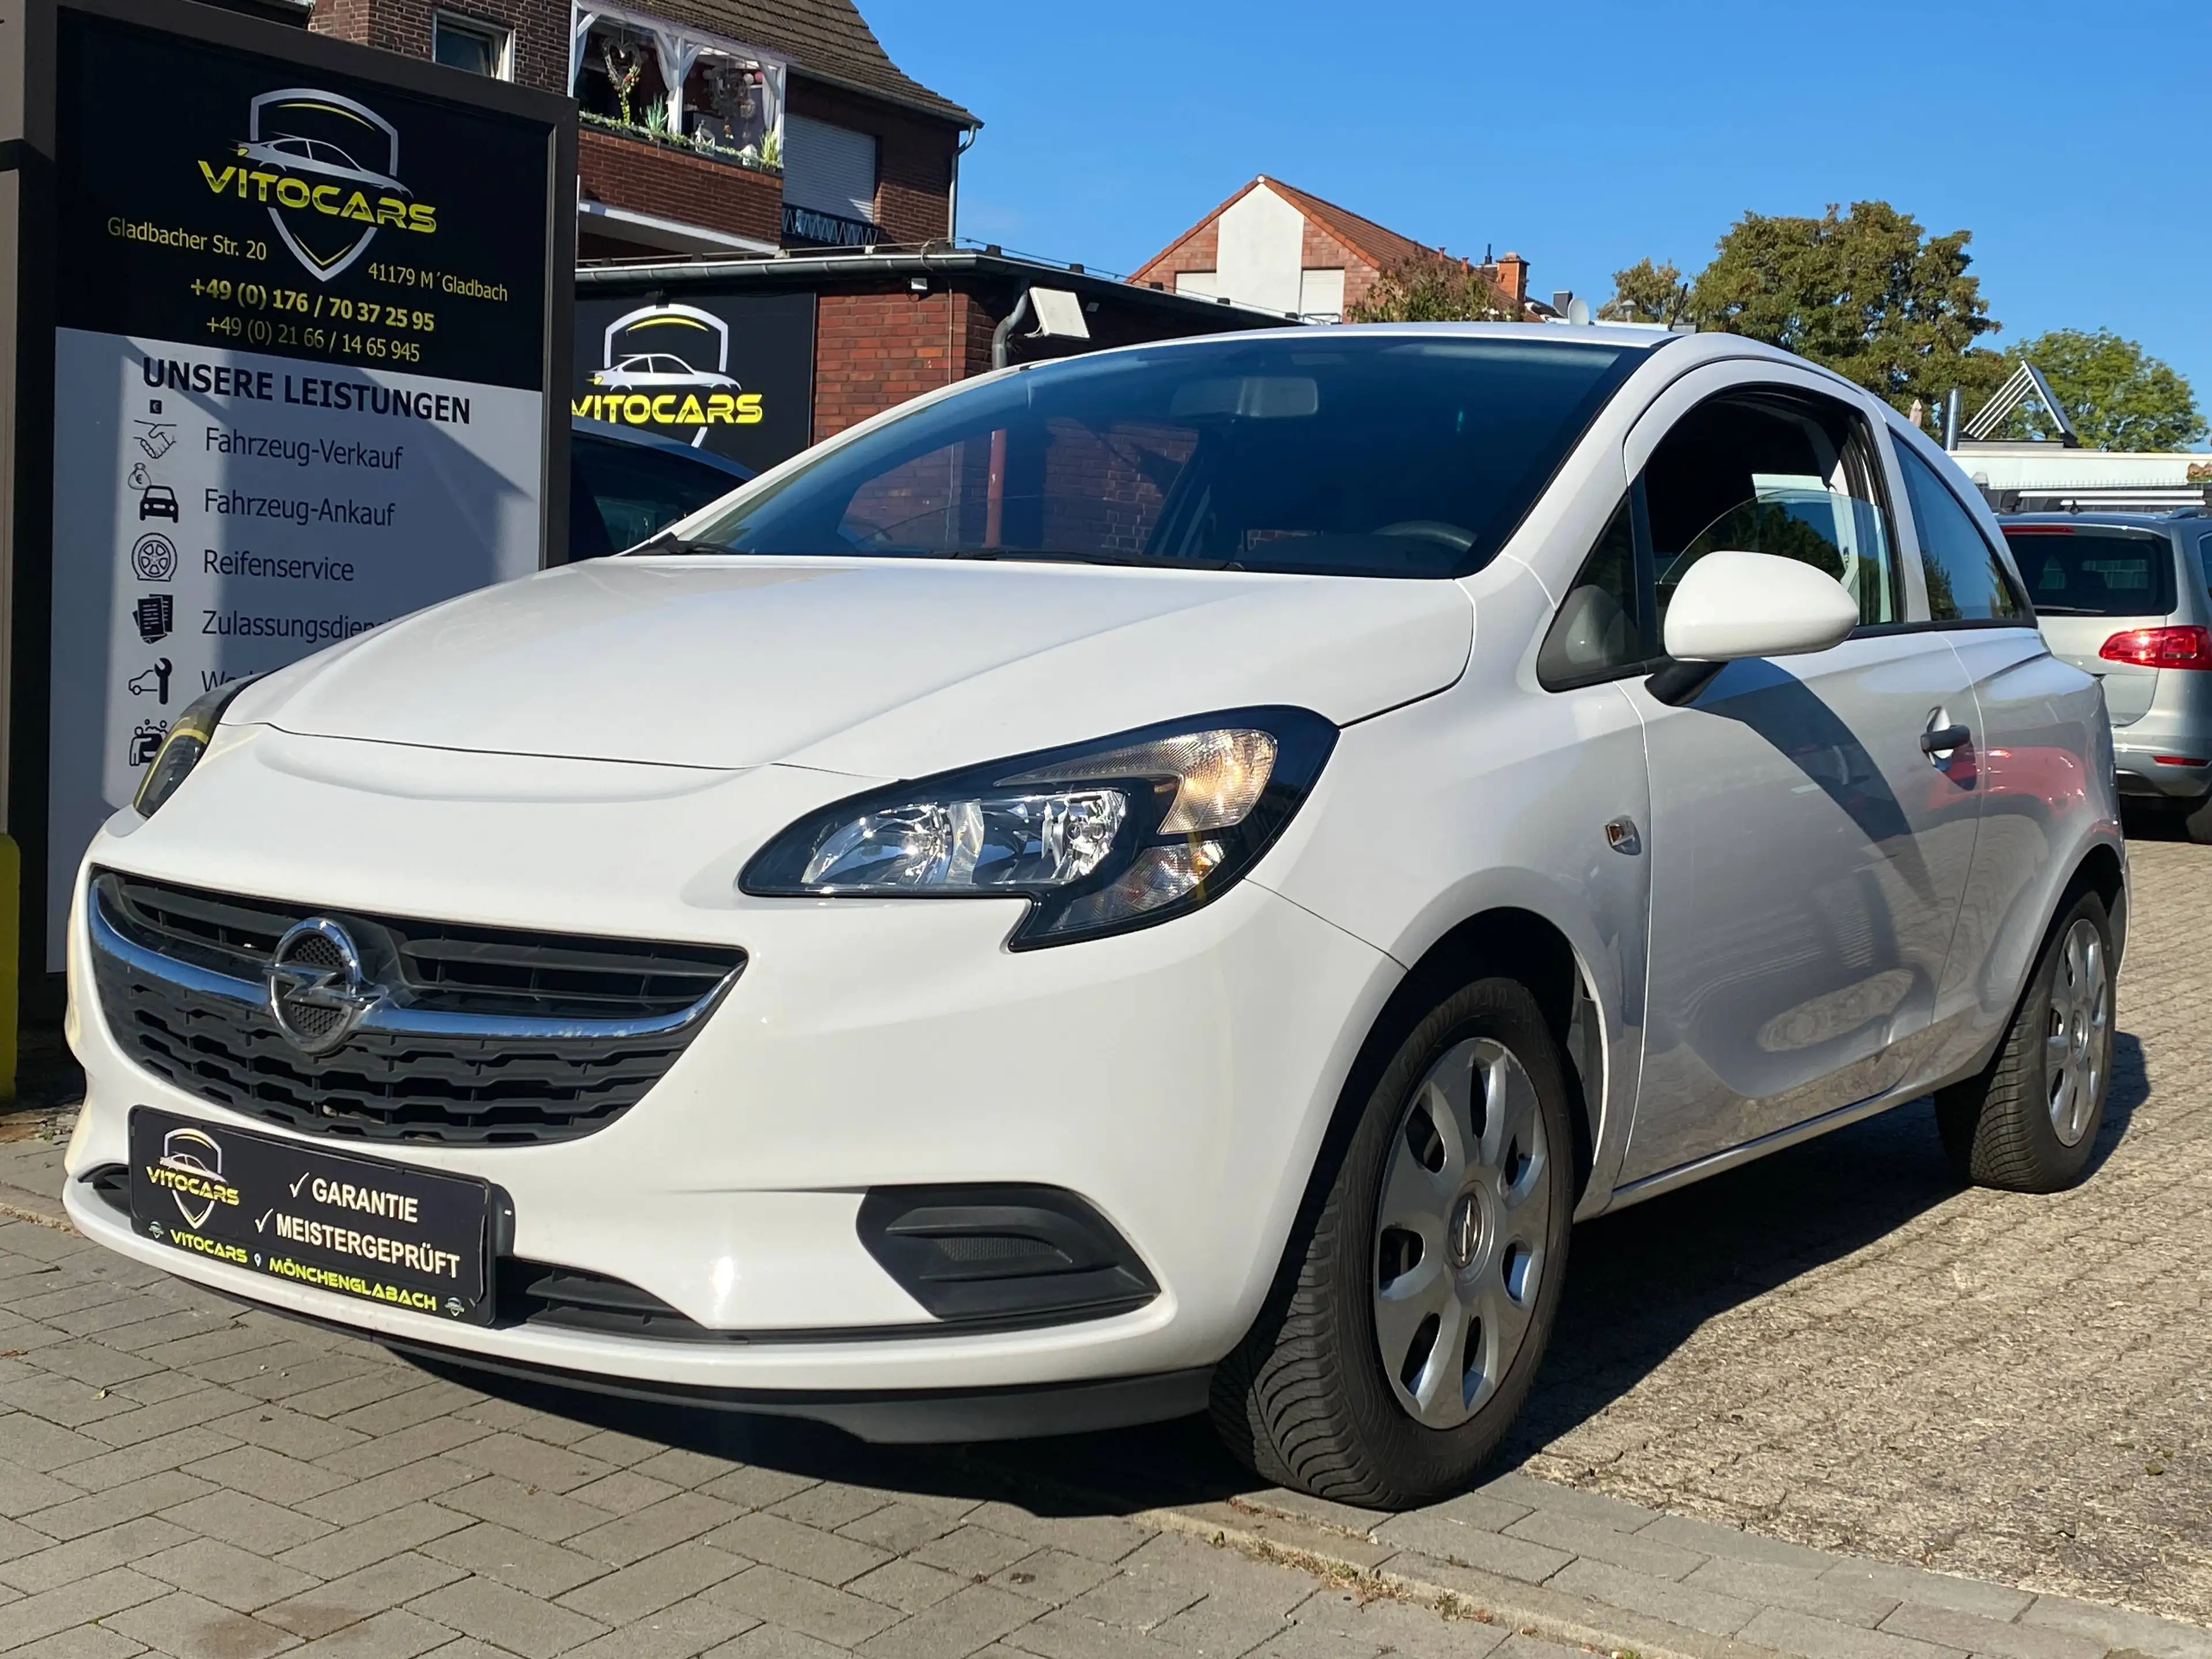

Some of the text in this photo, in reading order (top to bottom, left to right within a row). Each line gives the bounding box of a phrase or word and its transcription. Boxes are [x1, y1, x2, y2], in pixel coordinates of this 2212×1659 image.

[198, 160, 437, 233] VITOCARS
[108, 217, 267, 260] Gladbacher Str. 20
[368, 262, 415, 286] 41179
[191, 278, 435, 332] +49 (0) 176 / 70 37 25 95
[206, 316, 421, 362] +49 (0) 21 66 / 14 65 945
[143, 357, 470, 425] UNSERE LEISTUNGEN
[571, 394, 763, 424] VITOCARS
[206, 427, 403, 469] Fahrzeug-Verkauf
[204, 488, 396, 527] Fahrzeug-Ankauf
[204, 549, 354, 581] Reifenservice
[202, 610, 392, 645] Zulassungsdien
[146, 1166, 240, 1206] VITOCARS
[312, 1177, 419, 1223] GARANTIE
[276, 1213, 460, 1279] MEISTERGEPRÜFT
[170, 1228, 437, 1312] VITOCARS MÖNCHENGLABACH
